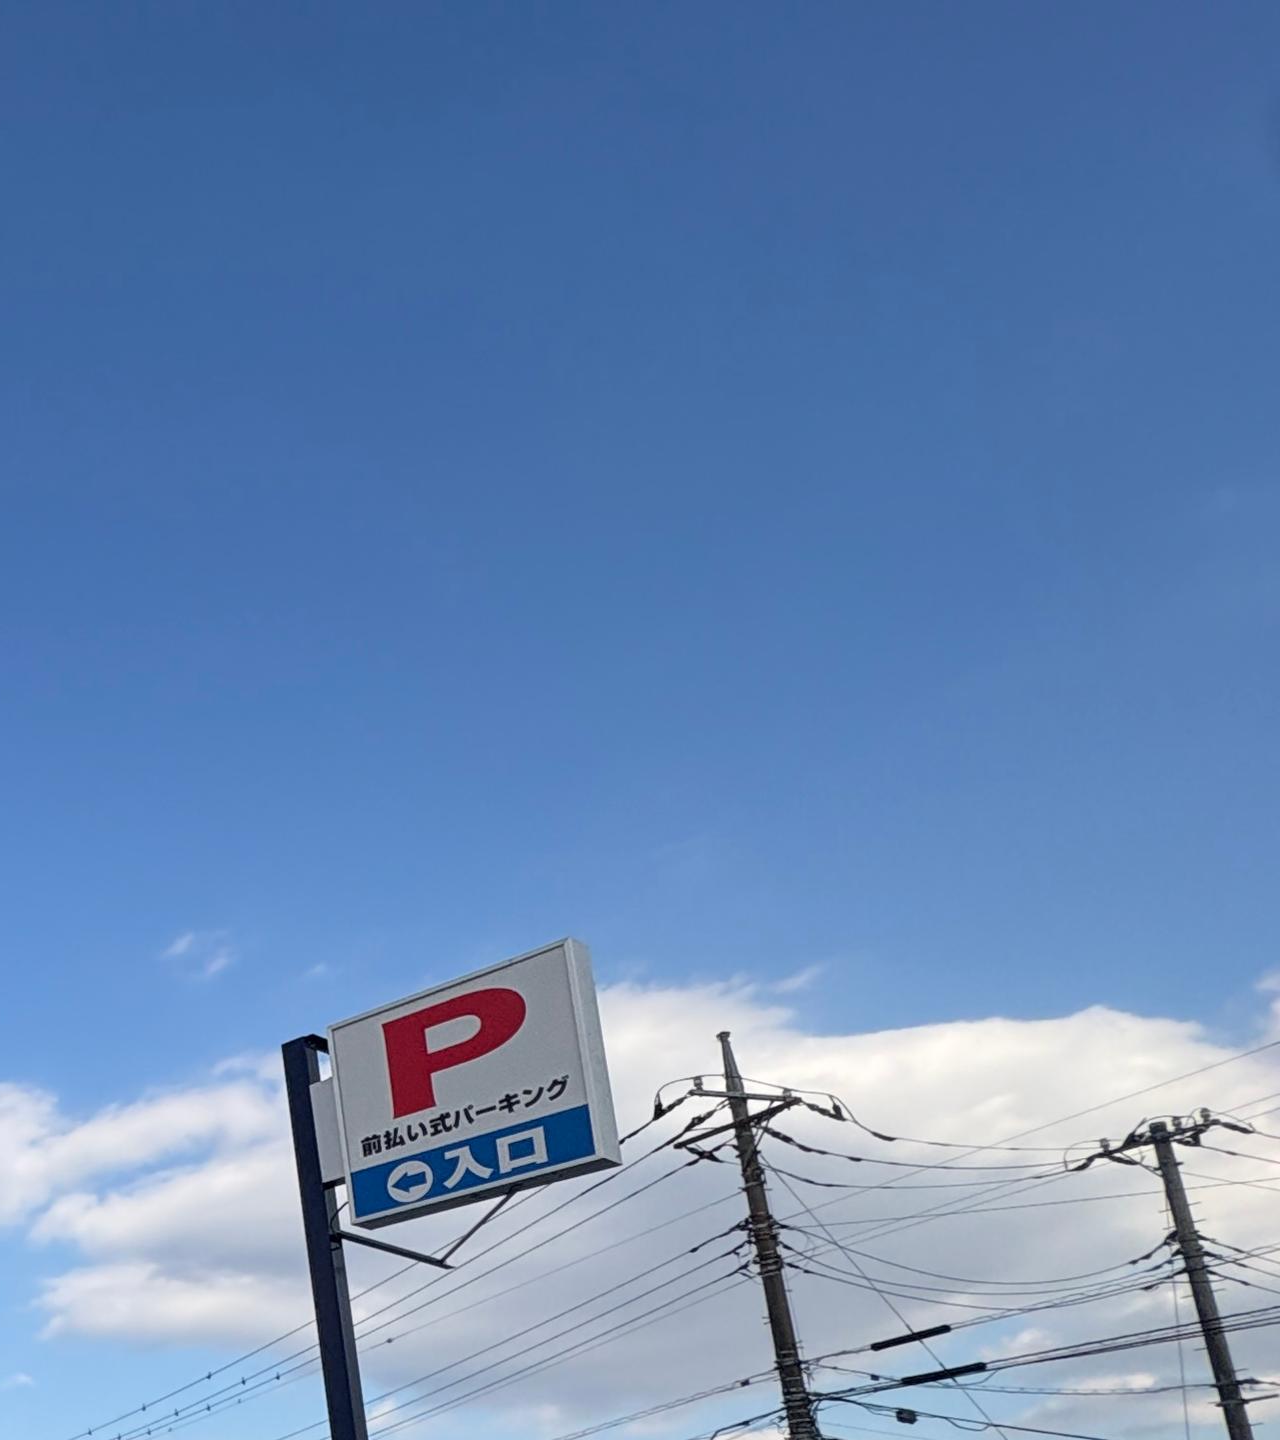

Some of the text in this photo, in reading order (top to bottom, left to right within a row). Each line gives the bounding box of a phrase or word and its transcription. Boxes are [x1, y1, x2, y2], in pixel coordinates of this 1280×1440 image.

[381, 987, 527, 1119] P
[361, 1074, 570, 1158] 前払い式パーキング
[442, 1126, 549, 1190] 入口
